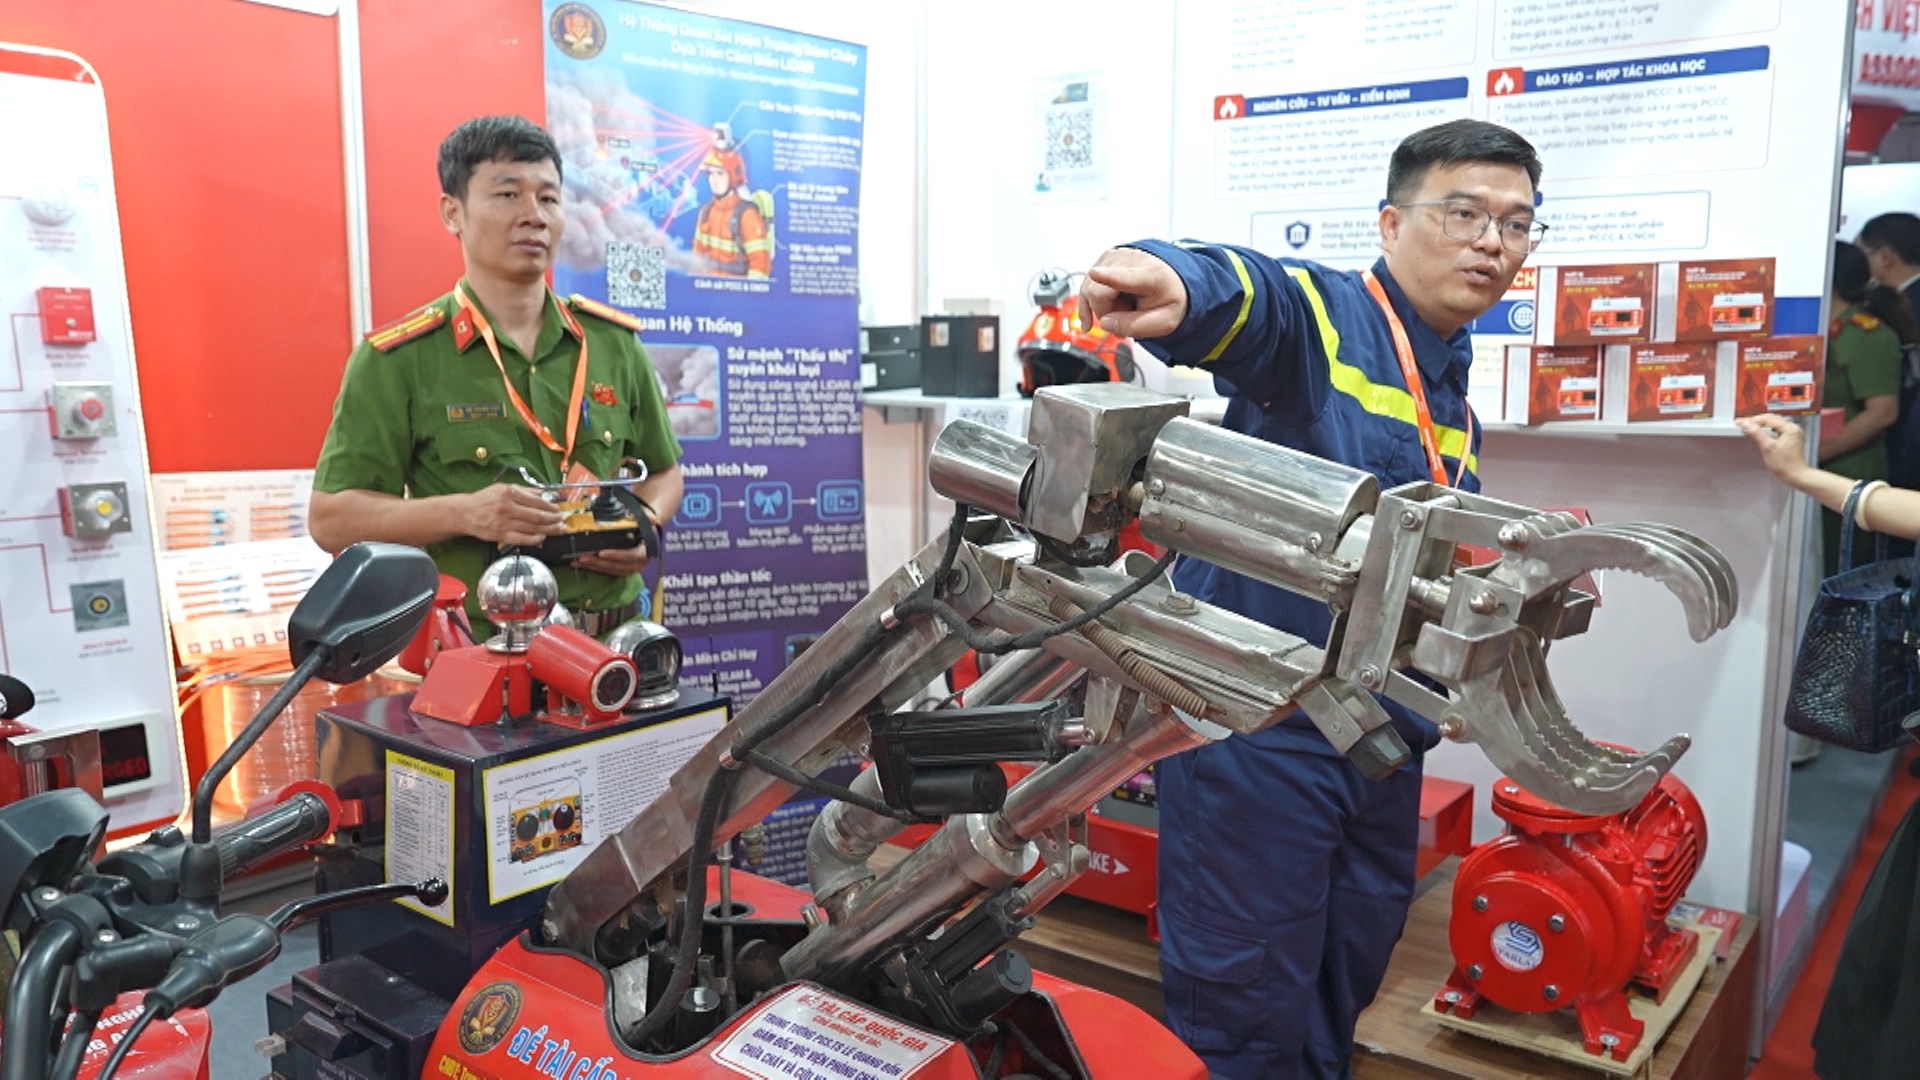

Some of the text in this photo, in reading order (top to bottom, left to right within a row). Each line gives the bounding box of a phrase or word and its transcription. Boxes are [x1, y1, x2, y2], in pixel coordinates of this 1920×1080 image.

[1535, 58, 1707, 88] ĐÀO TẠO HỢP TÁC KHOA HỌC
[669, 315, 693, 335] Hệ
[696, 315, 744, 338] Thống
[506, 1024, 550, 1066] ĐỀ
[534, 1037, 578, 1080] TÀI
